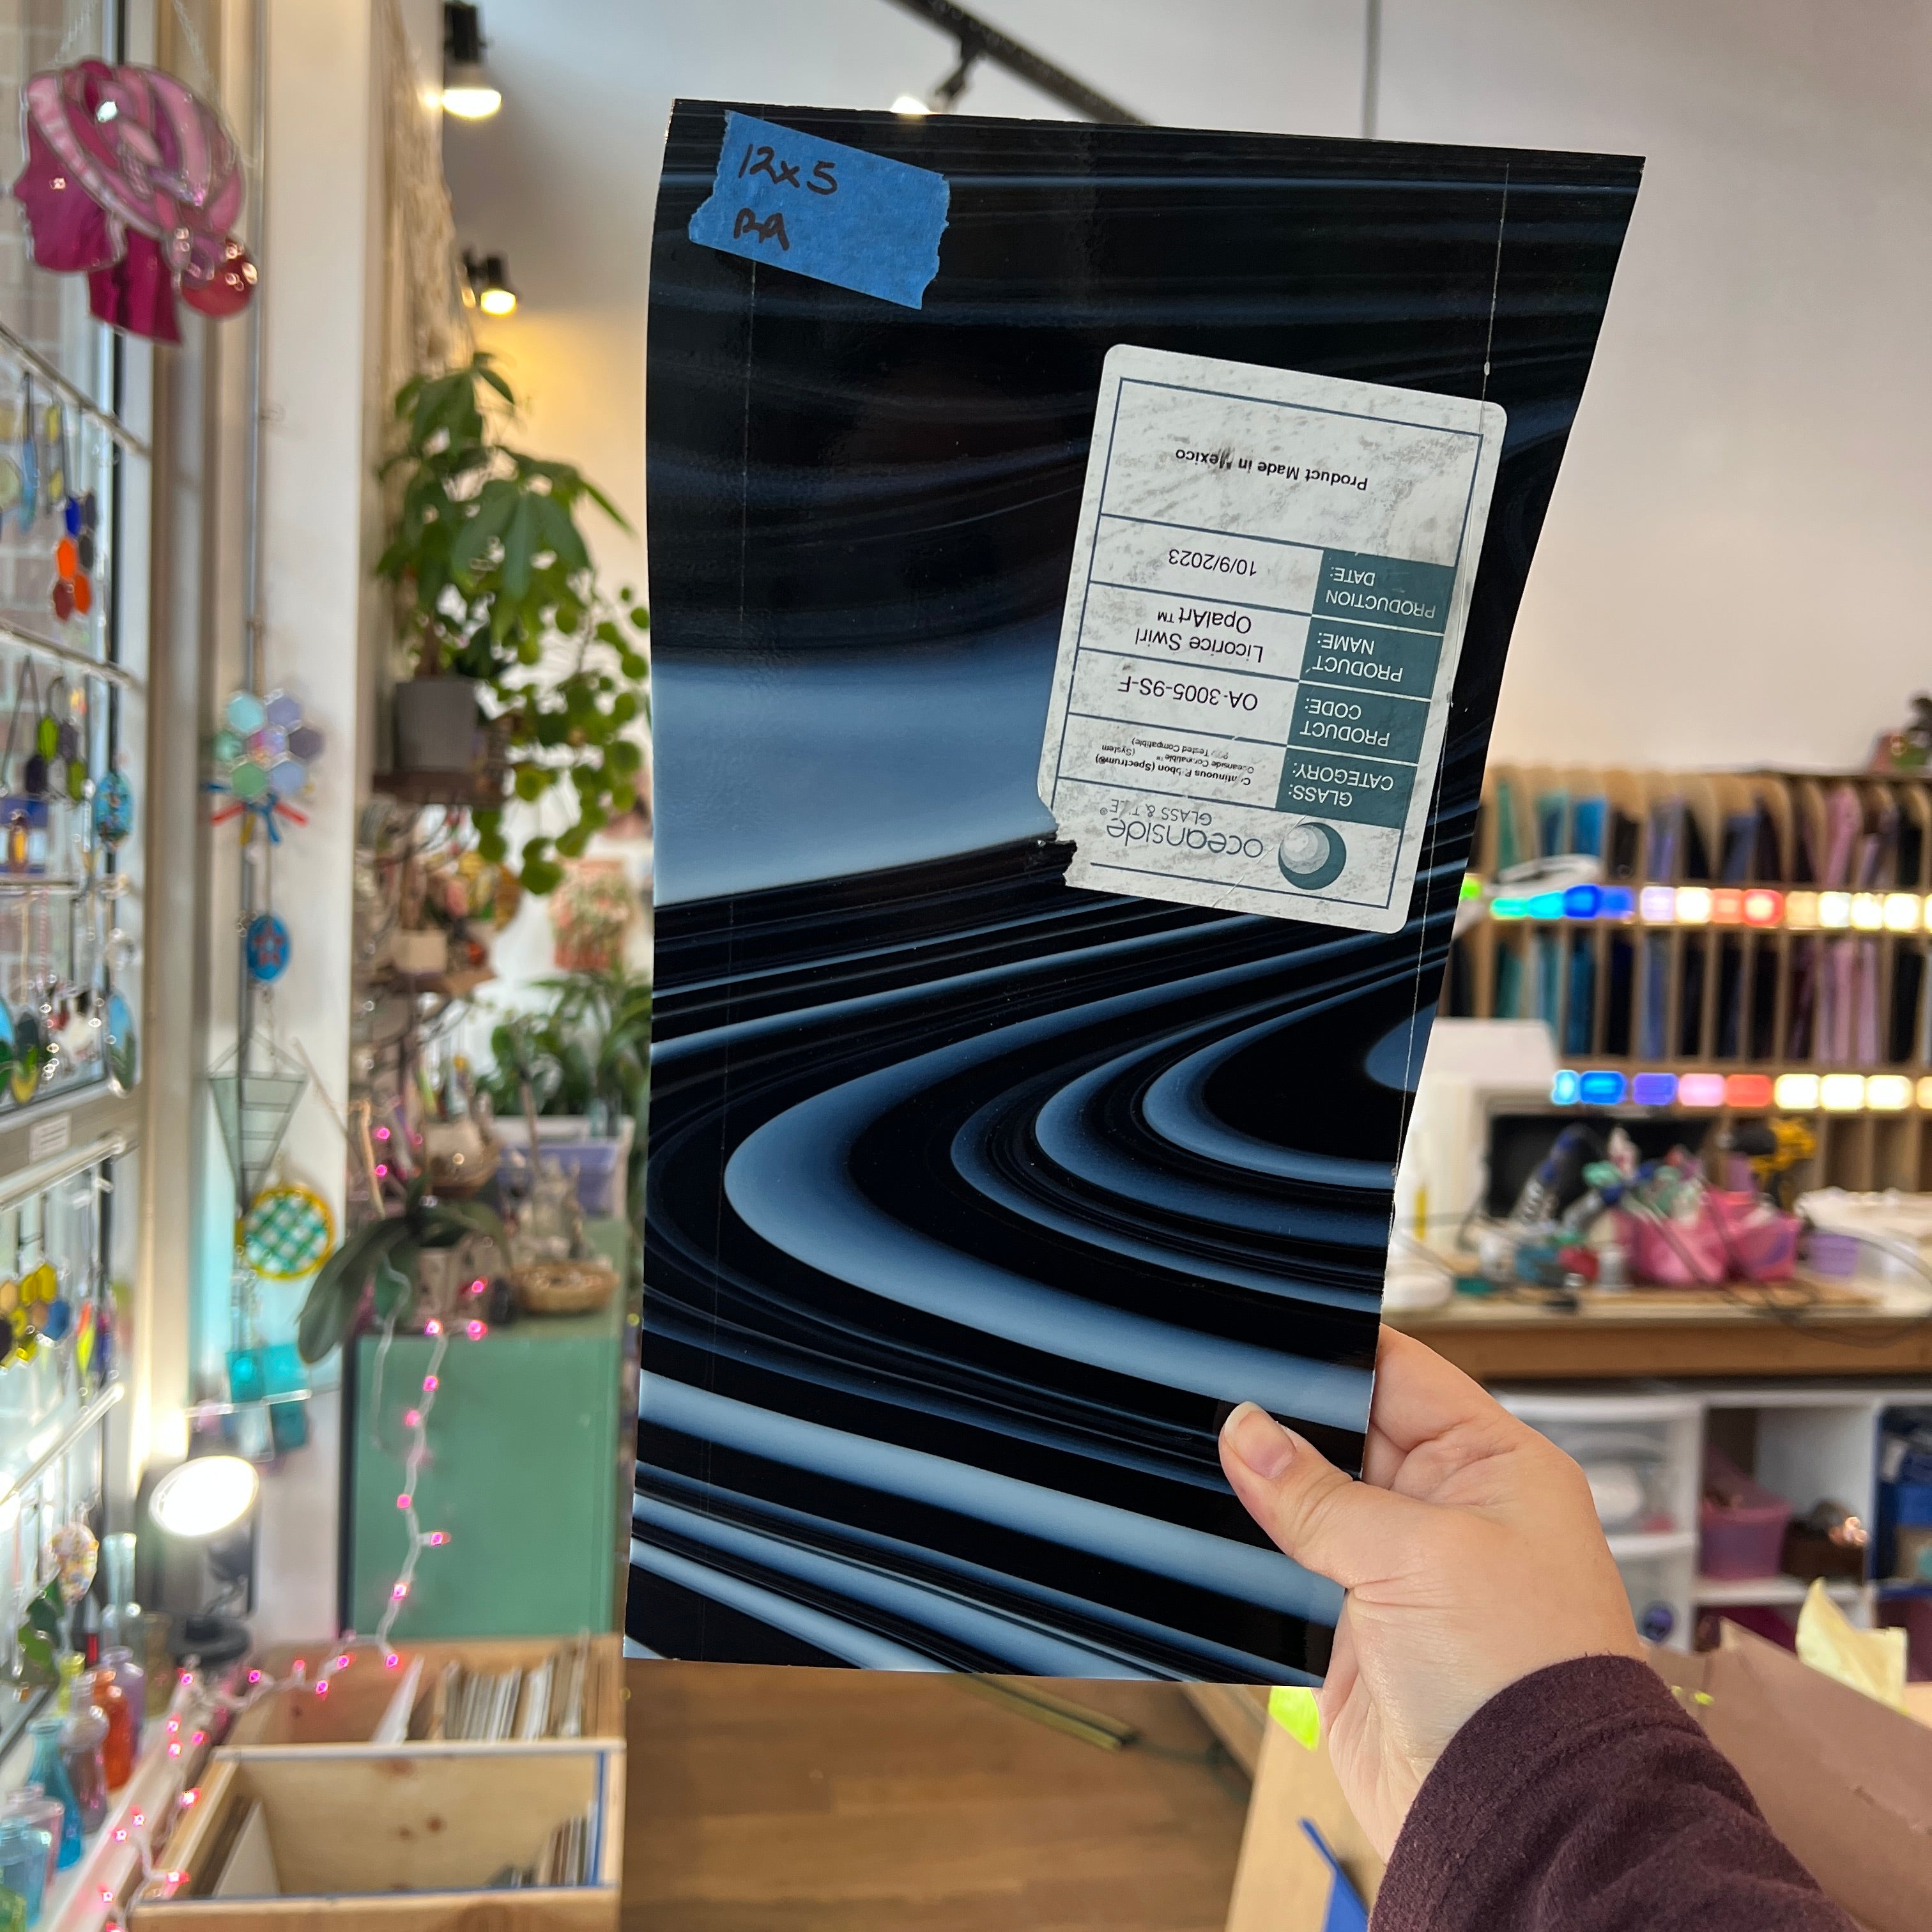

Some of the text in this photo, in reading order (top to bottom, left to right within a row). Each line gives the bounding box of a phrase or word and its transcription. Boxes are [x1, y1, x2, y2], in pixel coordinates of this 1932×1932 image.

[1175, 449, 1368, 491] Product Made in Mexico
[1168, 548, 1257, 577] 10/9/2023
[1330, 567, 1376, 586] DATE:
[1325, 589, 1436, 619] PRODUCTION
[1135, 627, 1264, 663] Licorice Swirl
[1316, 632, 1376, 656] NAME:
[1312, 656, 1404, 682] PRODUCT
[1117, 675, 1259, 712] OA-3005-9S-F
[1304, 698, 1362, 721] CODE:
[1131, 737, 1181, 753] Compatible)
[1299, 720, 1391, 747] PRODUCT
[1101, 744, 1135, 757] (System
[1182, 745, 1209, 756] Tested
[1095, 753, 1252, 786] Cntinuous Rbbon (Spectrum®)
[1211, 761, 1255, 774] Oeanside
[1292, 762, 1394, 792] CATEGORY:
[1288, 784, 1353, 808] GLASS:
[1145, 804, 1156, 817] &
[1161, 807, 1213, 827] GLASS
[1106, 818, 1264, 858] oceanside
